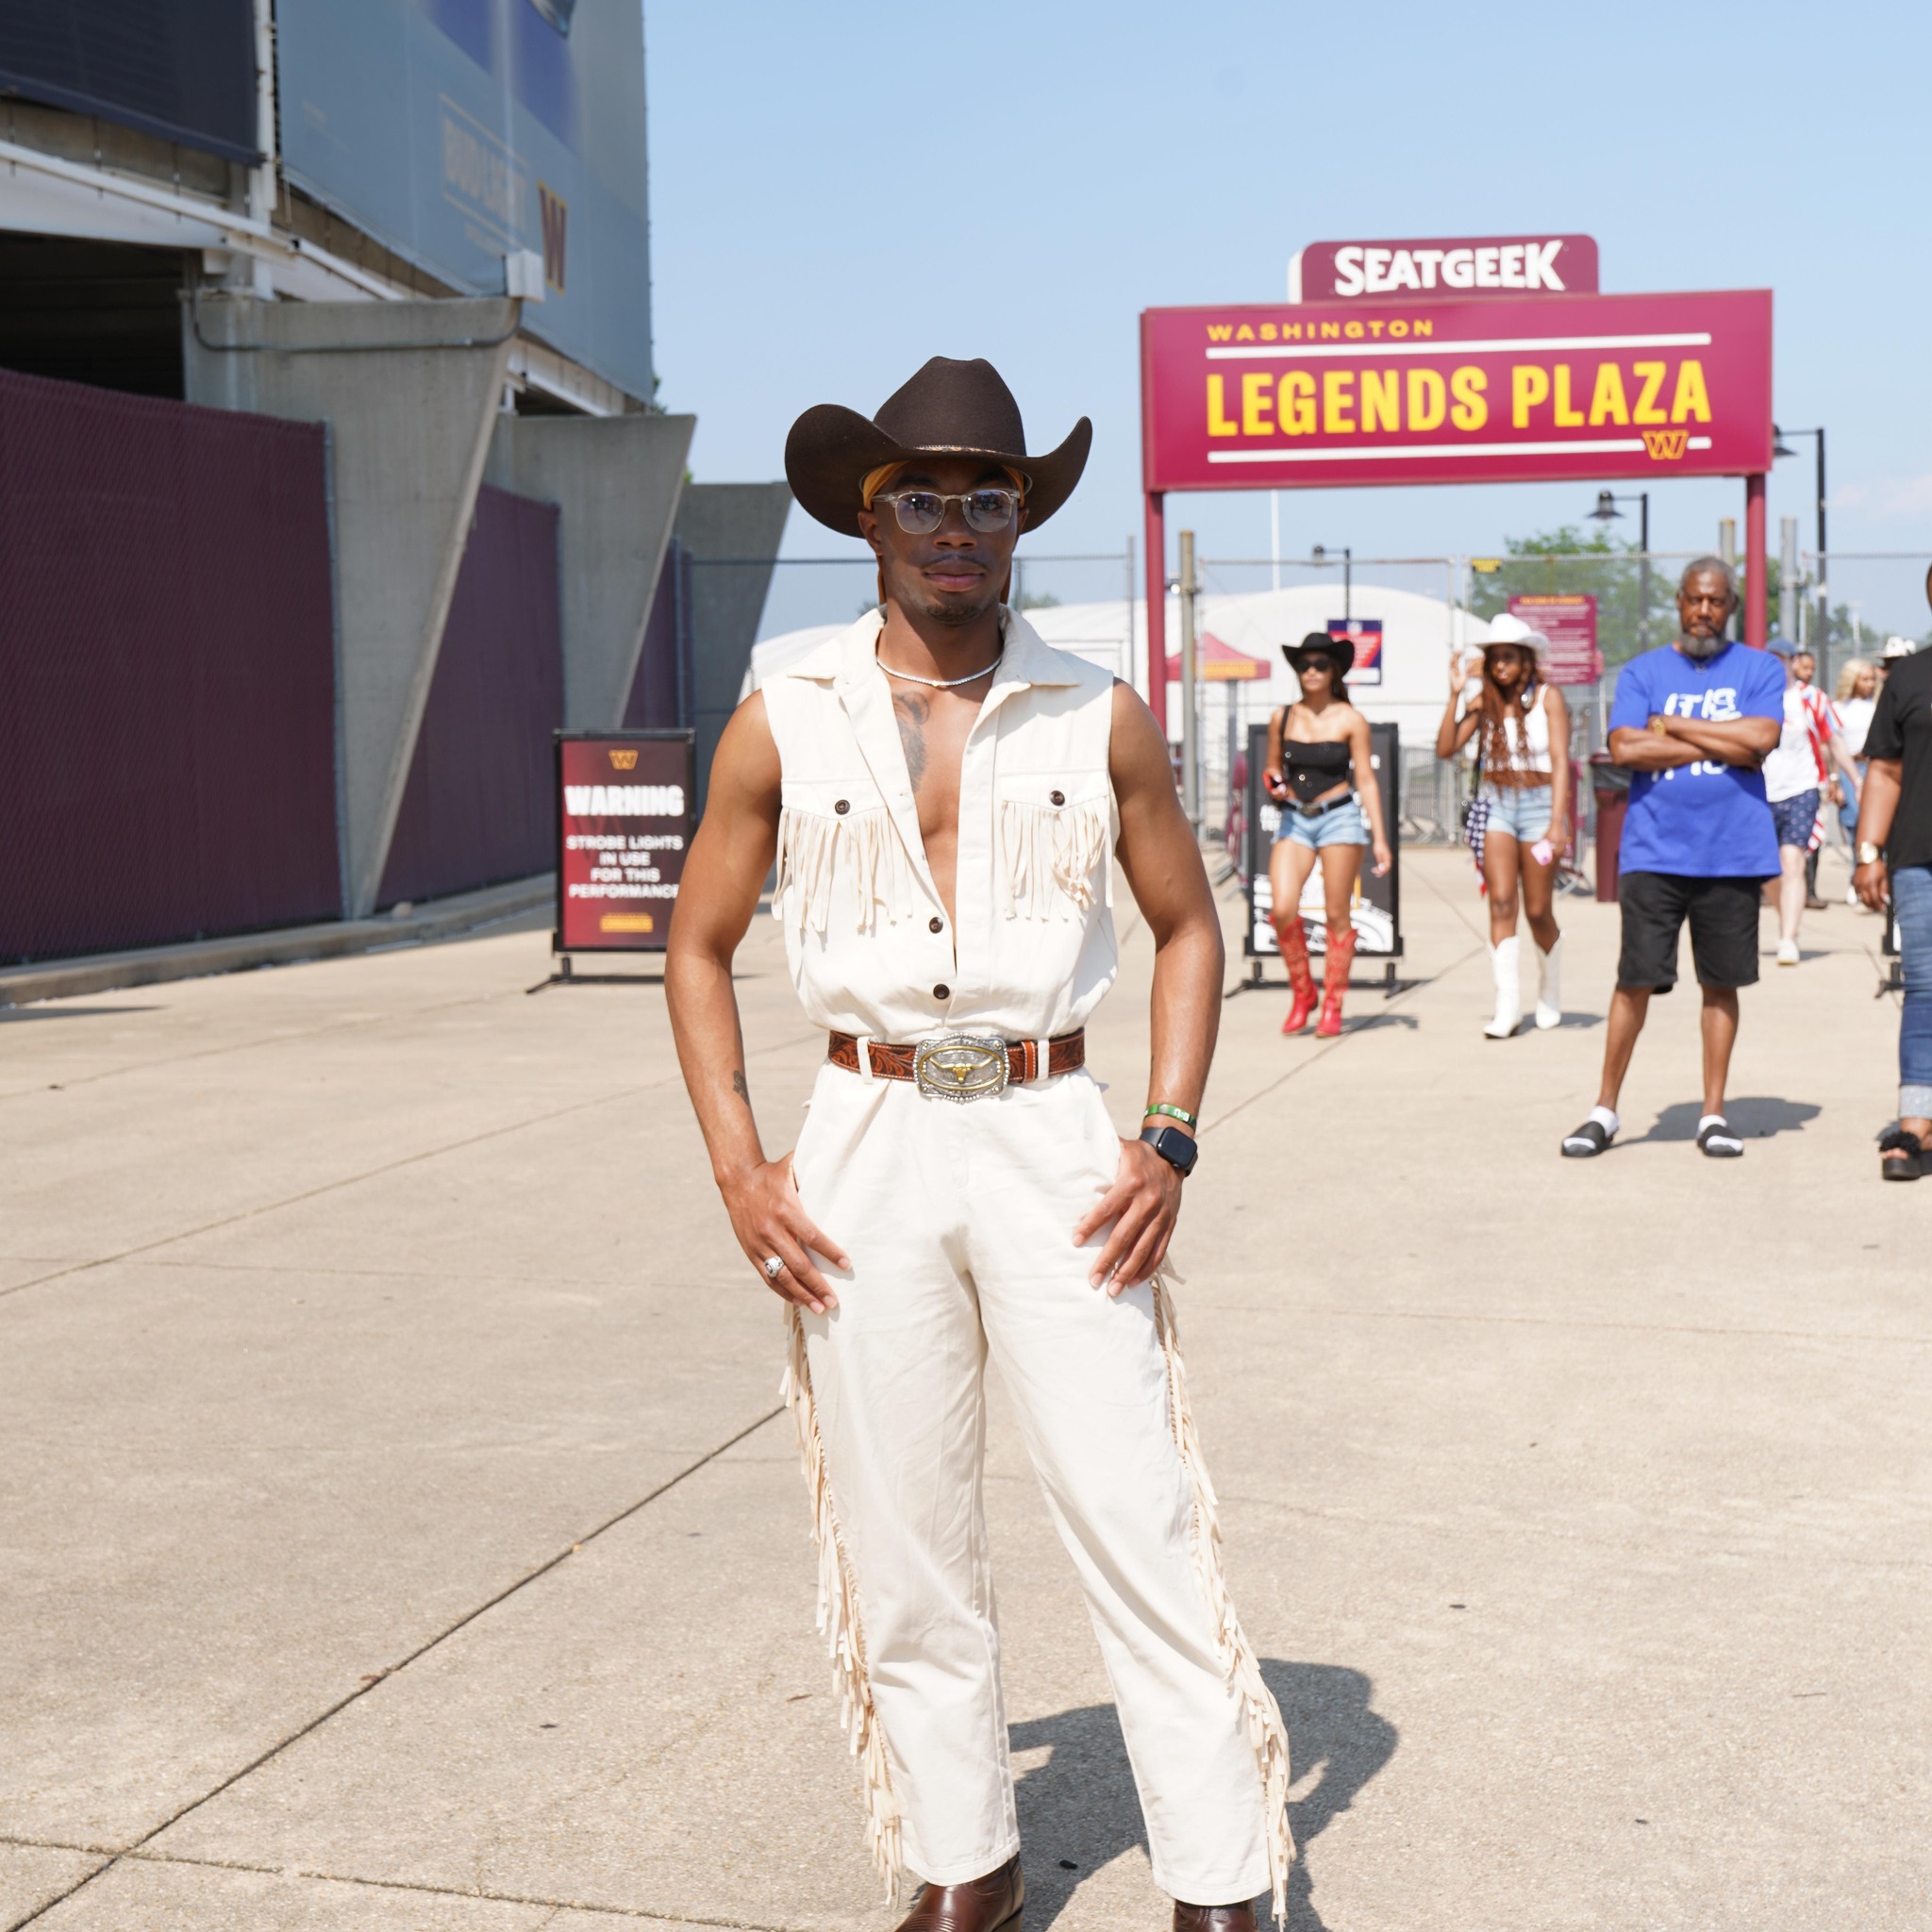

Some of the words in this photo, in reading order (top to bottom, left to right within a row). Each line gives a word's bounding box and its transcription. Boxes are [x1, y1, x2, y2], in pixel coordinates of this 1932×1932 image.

[1334, 240, 1565, 296] SEATGEEK
[1207, 320, 1433, 342] WASHINGTON
[1207, 365, 1489, 437] LEGENDS
[1512, 359, 1712, 428] PLAZA
[564, 785, 684, 816] WARNING
[566, 835, 626, 851] STROBE
[628, 835, 684, 851] LIGHTS
[599, 852, 617, 866] IN
[619, 852, 651, 866] USE
[591, 868, 622, 882] FOR
[625, 868, 660, 882] THIS
